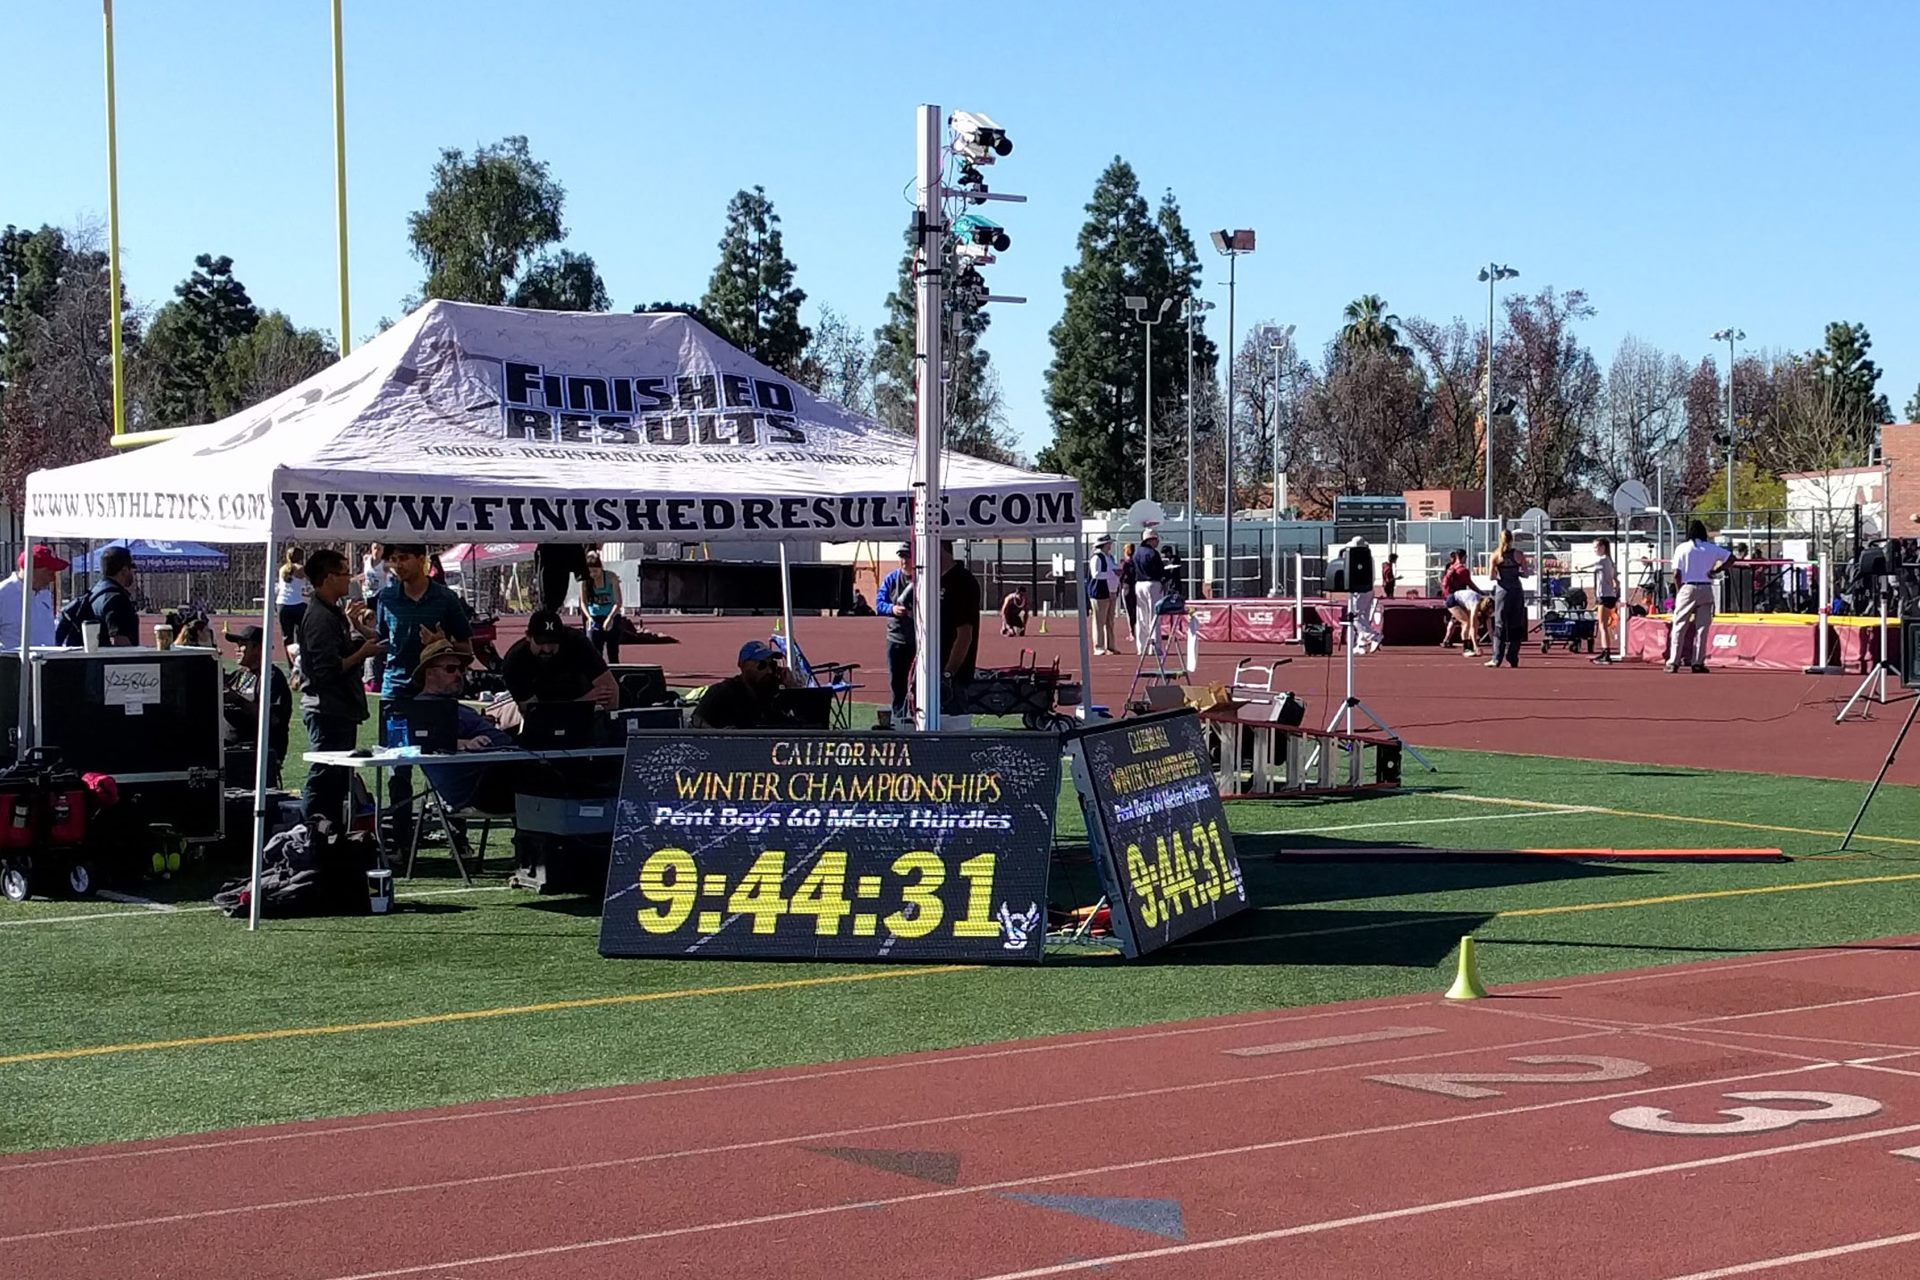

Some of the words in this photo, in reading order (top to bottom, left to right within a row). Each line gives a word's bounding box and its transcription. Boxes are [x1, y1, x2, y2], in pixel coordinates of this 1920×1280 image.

[505, 406, 807, 445] RESULTS
[420, 445, 502, 457] TIMING
[32, 492, 266, 521] WWW.VSATHLETICS.COM
[1247, 611, 1274, 621] UCS
[771, 741, 912, 767] CALIFORNIA
[674, 770, 783, 801] WINTER
[787, 771, 1002, 804] CHAMPIONSHIPS
[654, 806, 716, 827] Pent
[719, 807, 782, 834] Boys
[786, 808, 821, 828] 60
[828, 807, 904, 829] Meter
[909, 807, 1012, 830] Hurdles
[1126, 821, 1237, 928] 9:44:31
[637, 847, 1001, 938] 9:44:31
[1608, 1089, 1883, 1135] 3
